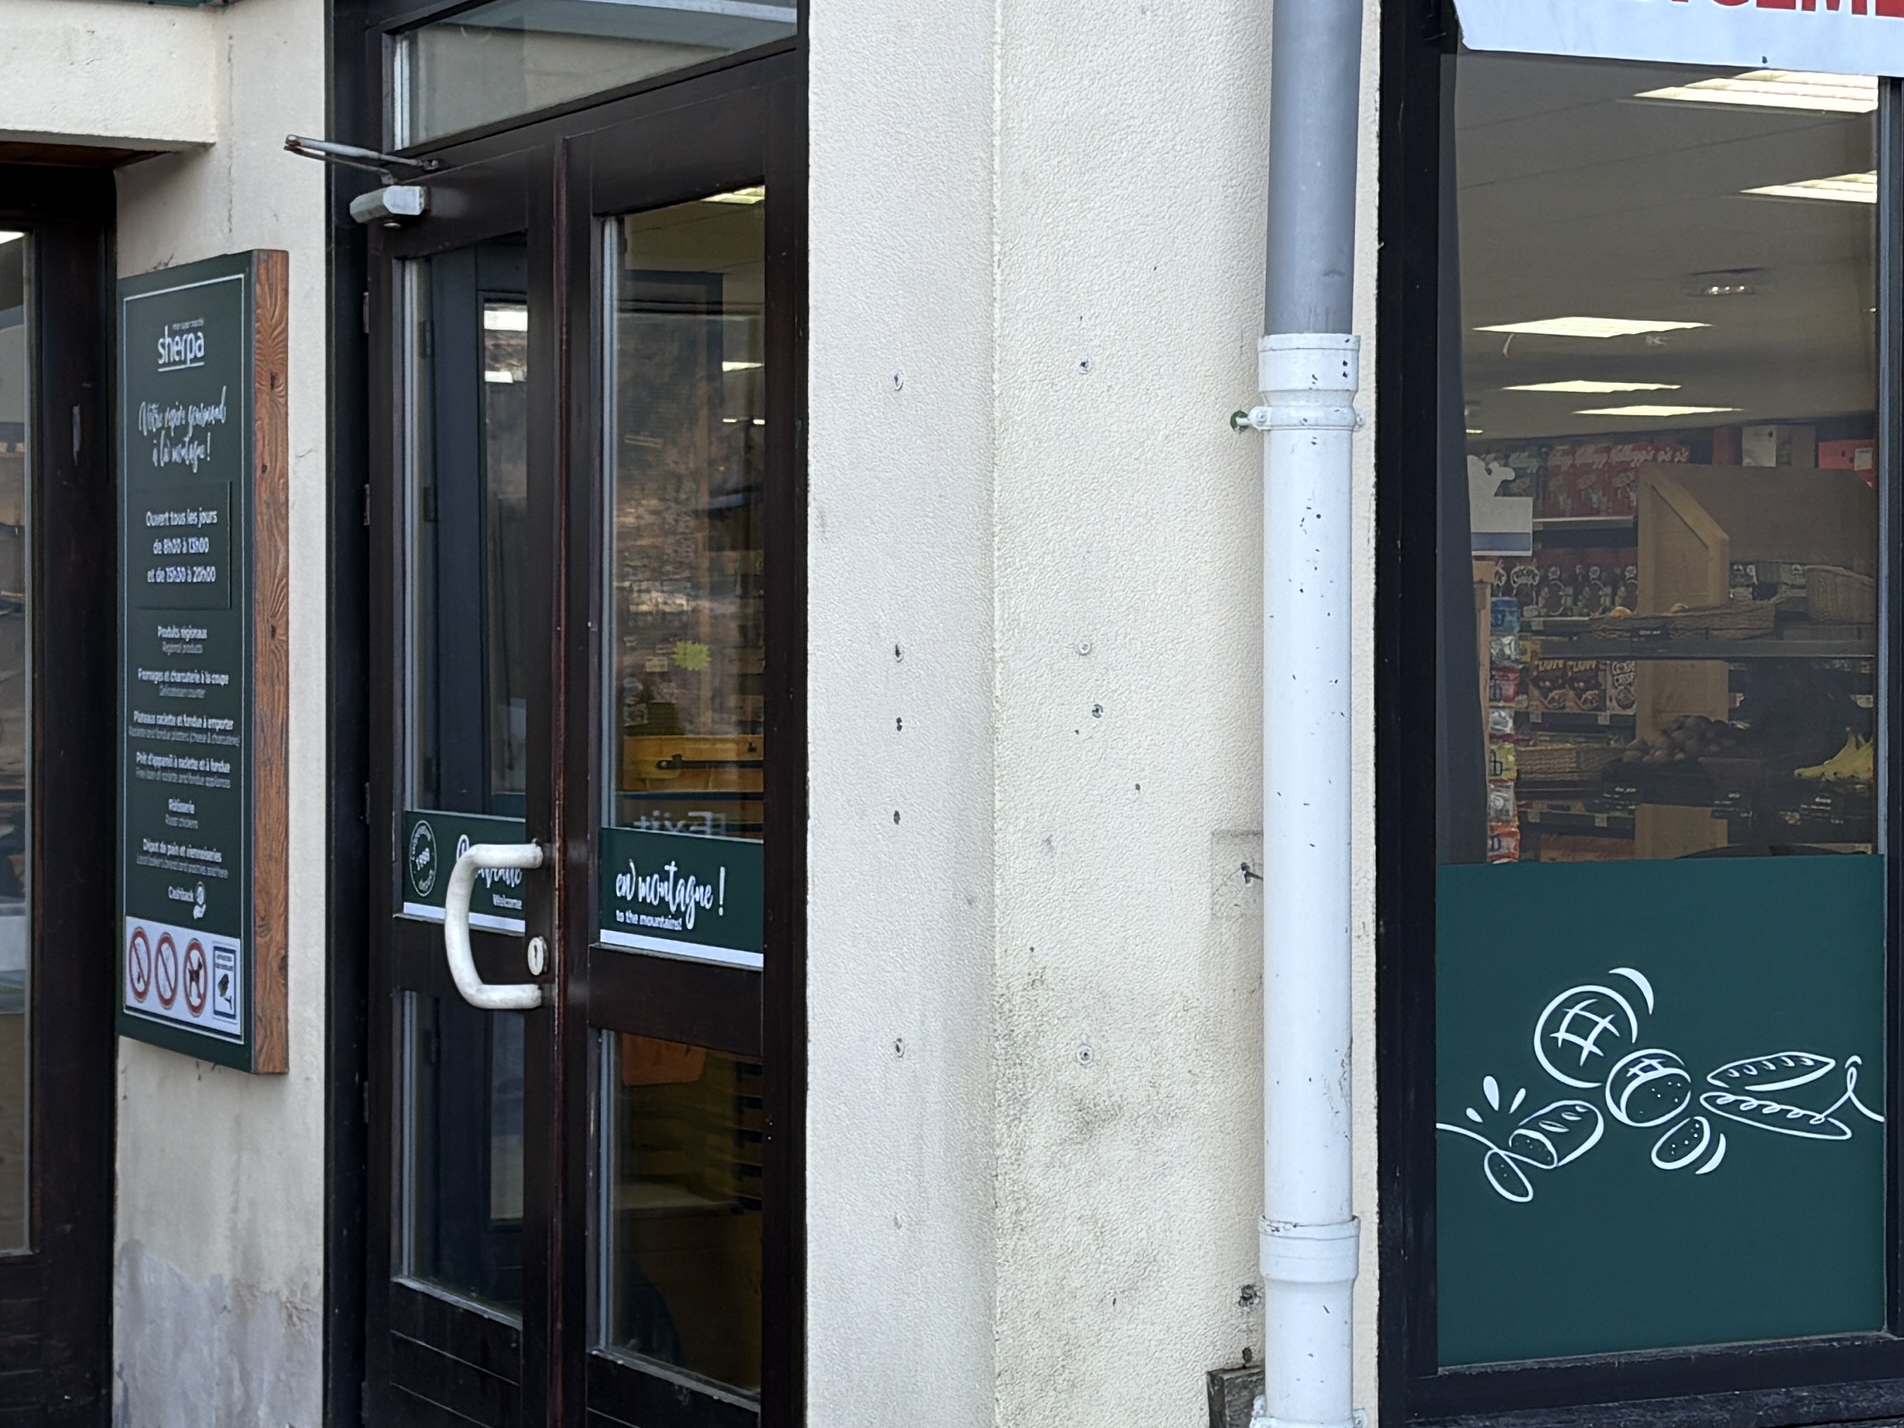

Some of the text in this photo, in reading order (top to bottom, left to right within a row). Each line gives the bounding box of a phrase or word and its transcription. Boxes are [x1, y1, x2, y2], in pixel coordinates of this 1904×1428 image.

[157, 325, 205, 366] sherpa
[198, 507, 218, 528] jours
[638, 860, 714, 930] montagne
